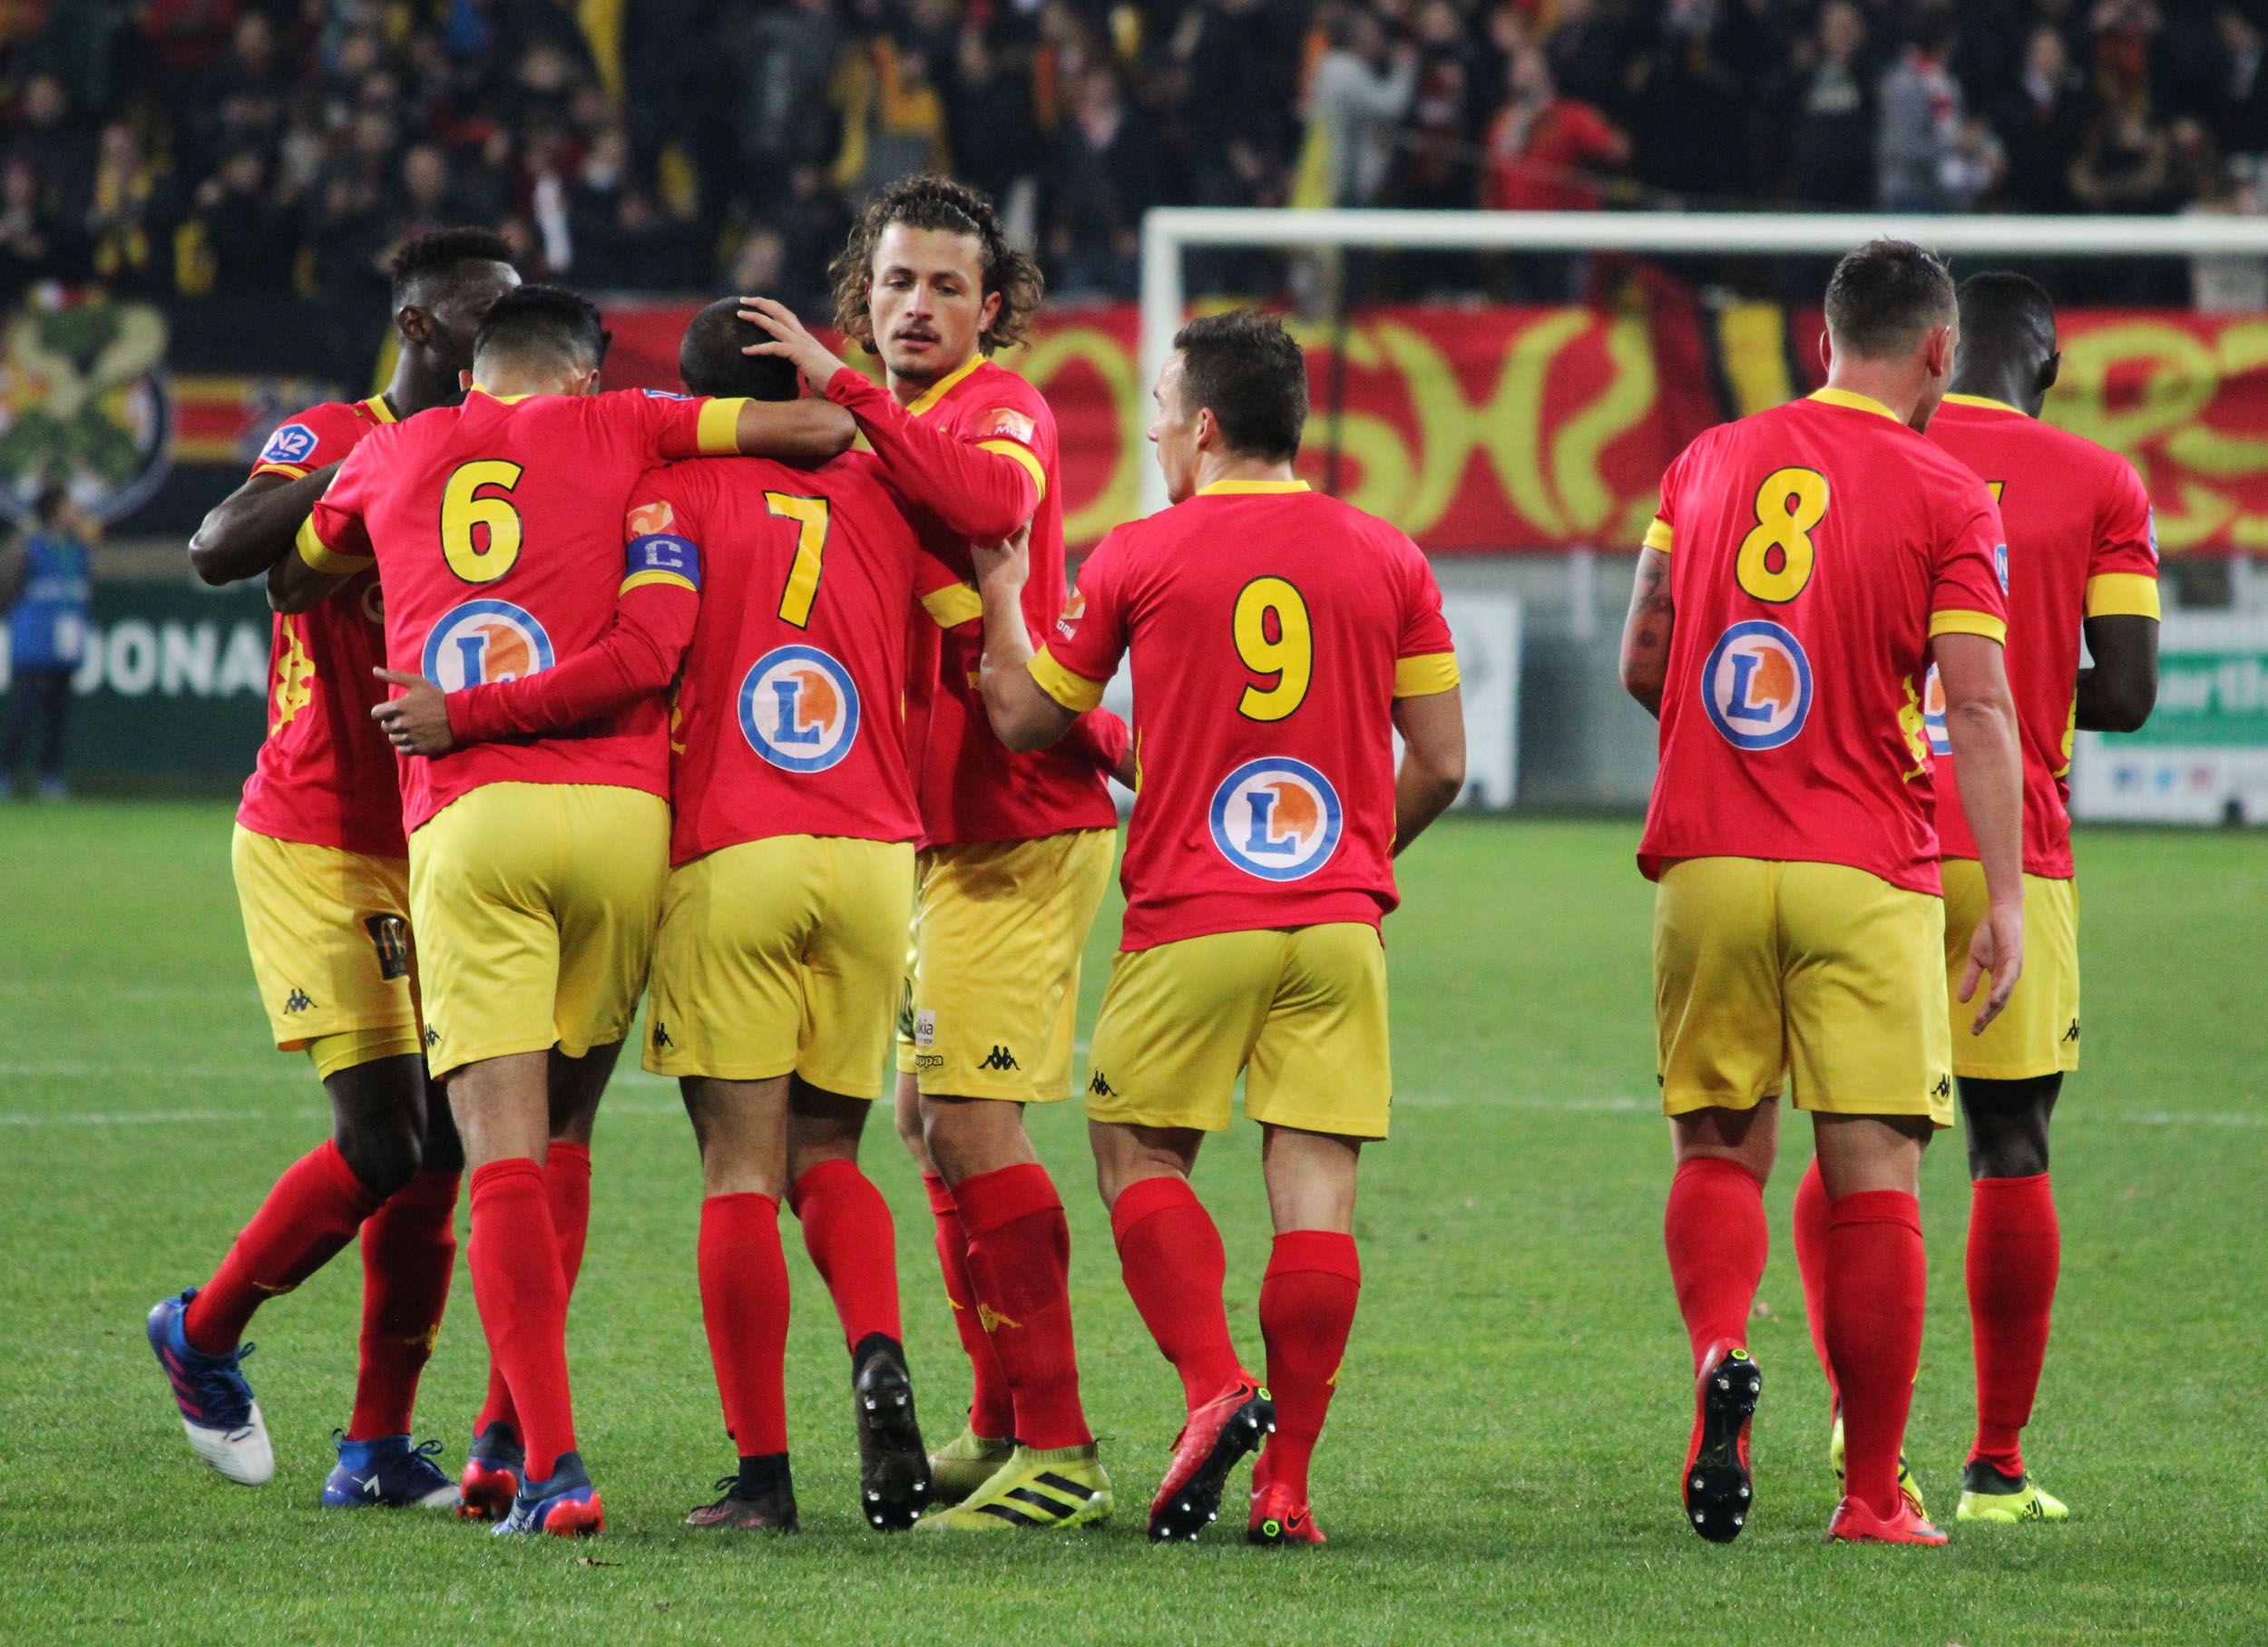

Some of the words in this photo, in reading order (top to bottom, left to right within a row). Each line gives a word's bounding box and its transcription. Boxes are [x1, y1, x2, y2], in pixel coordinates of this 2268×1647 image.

[443, 459, 523, 584] 6
[645, 541, 682, 567] C
[1735, 466, 1830, 603] 8
[763, 491, 830, 629] 7
[1232, 576, 1313, 722] 9
[773, 680, 821, 744] L
[1726, 654, 1775, 721] L
[1246, 792, 1296, 854] L
[917, 1018, 934, 1035] kia
